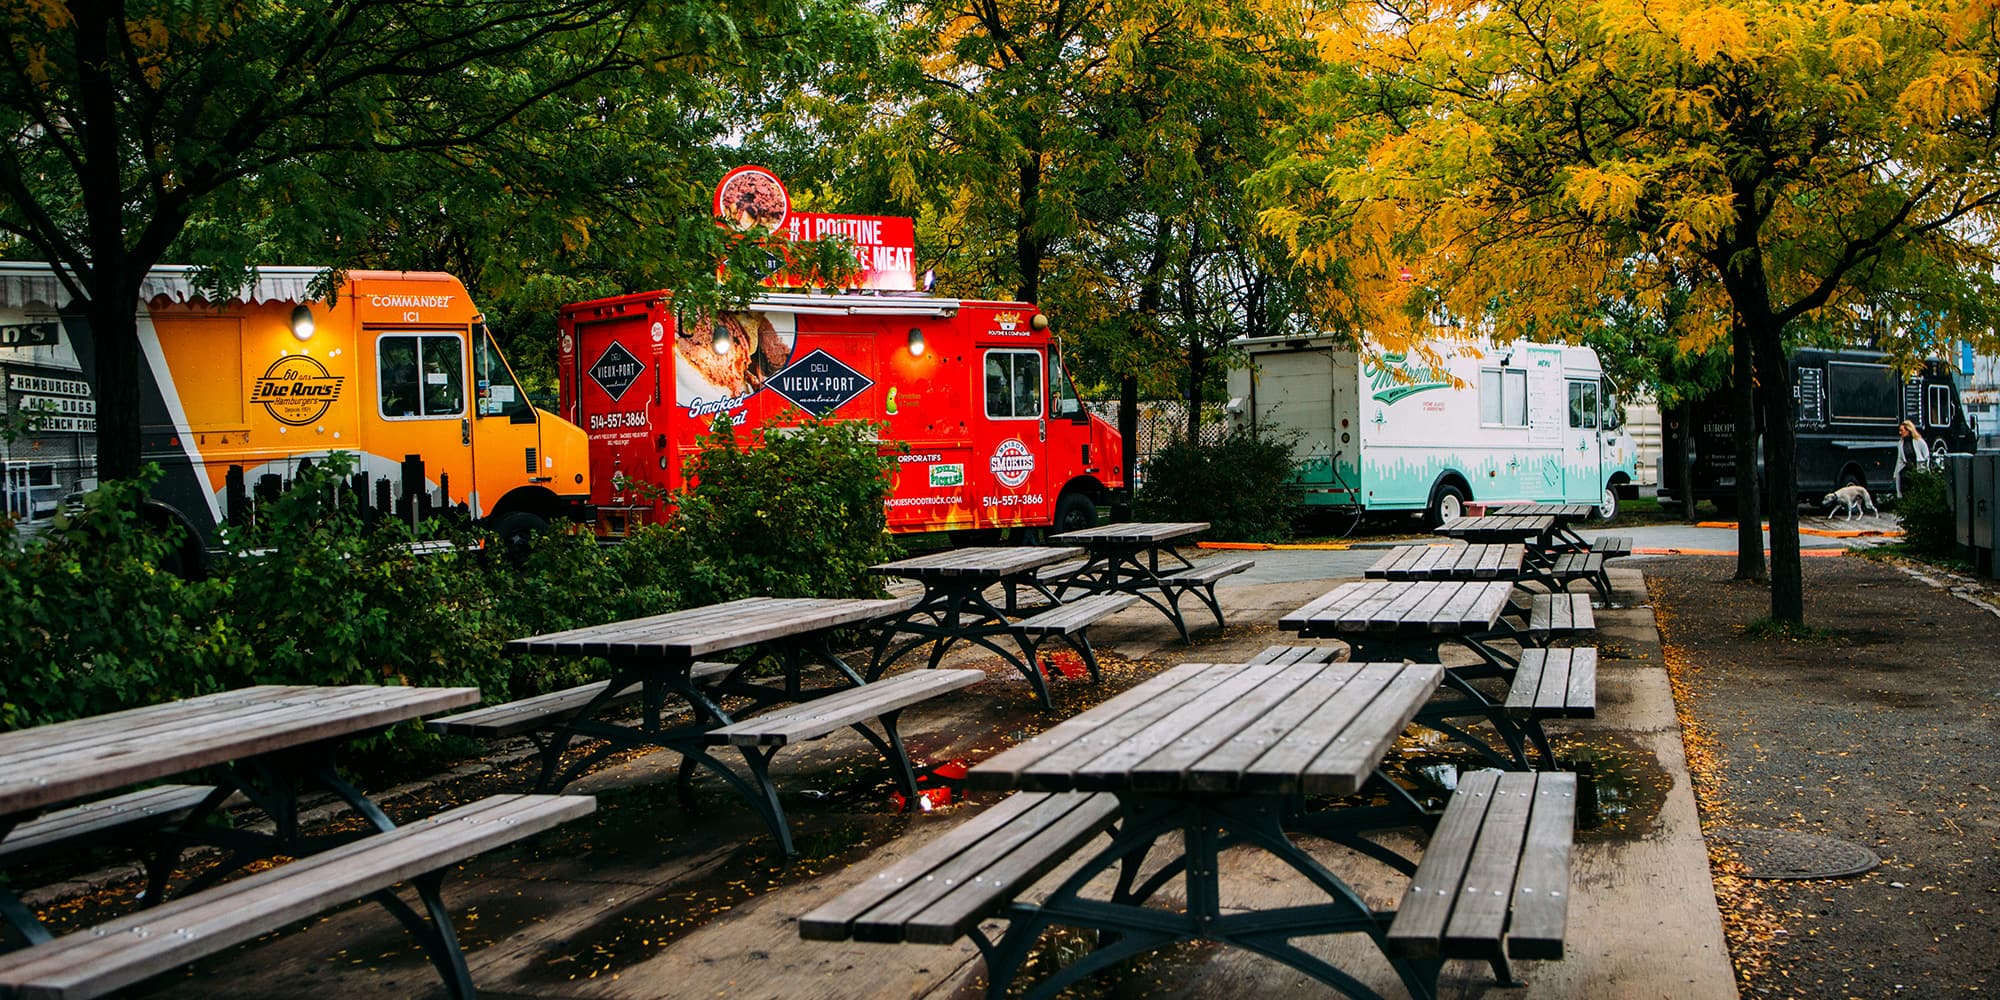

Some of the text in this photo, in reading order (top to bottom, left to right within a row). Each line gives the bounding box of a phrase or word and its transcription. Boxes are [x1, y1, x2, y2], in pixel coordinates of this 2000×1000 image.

[815, 218, 883, 245] POUTINE
[873, 247, 913, 271] MEAT
[372, 296, 449, 308] COMMANDEZ
[403, 311, 419, 322] ICI
[283, 369, 299, 381] 60
[597, 363, 635, 379] VIEUX-PORT
[810, 363, 829, 373] DELI
[17, 377, 88, 395] HAMBURGERS
[261, 383, 333, 397] Dic Ann's
[783, 377, 855, 391] VIEUX-PORT
[274, 397, 318, 406] Hamburgers
[689, 393, 744, 418] Smoked
[42, 417, 97, 432] RENCH FRIE
[591, 411, 646, 429] 514-557-3866
[999, 442, 1024, 453] MAISON
[897, 454, 942, 463] ORPORATIFS
[991, 456, 1033, 472] SMOKIES
[884, 496, 963, 508] MOKIESFOODTRUCK.COM
[982, 494, 1043, 507] 514-557-3866
